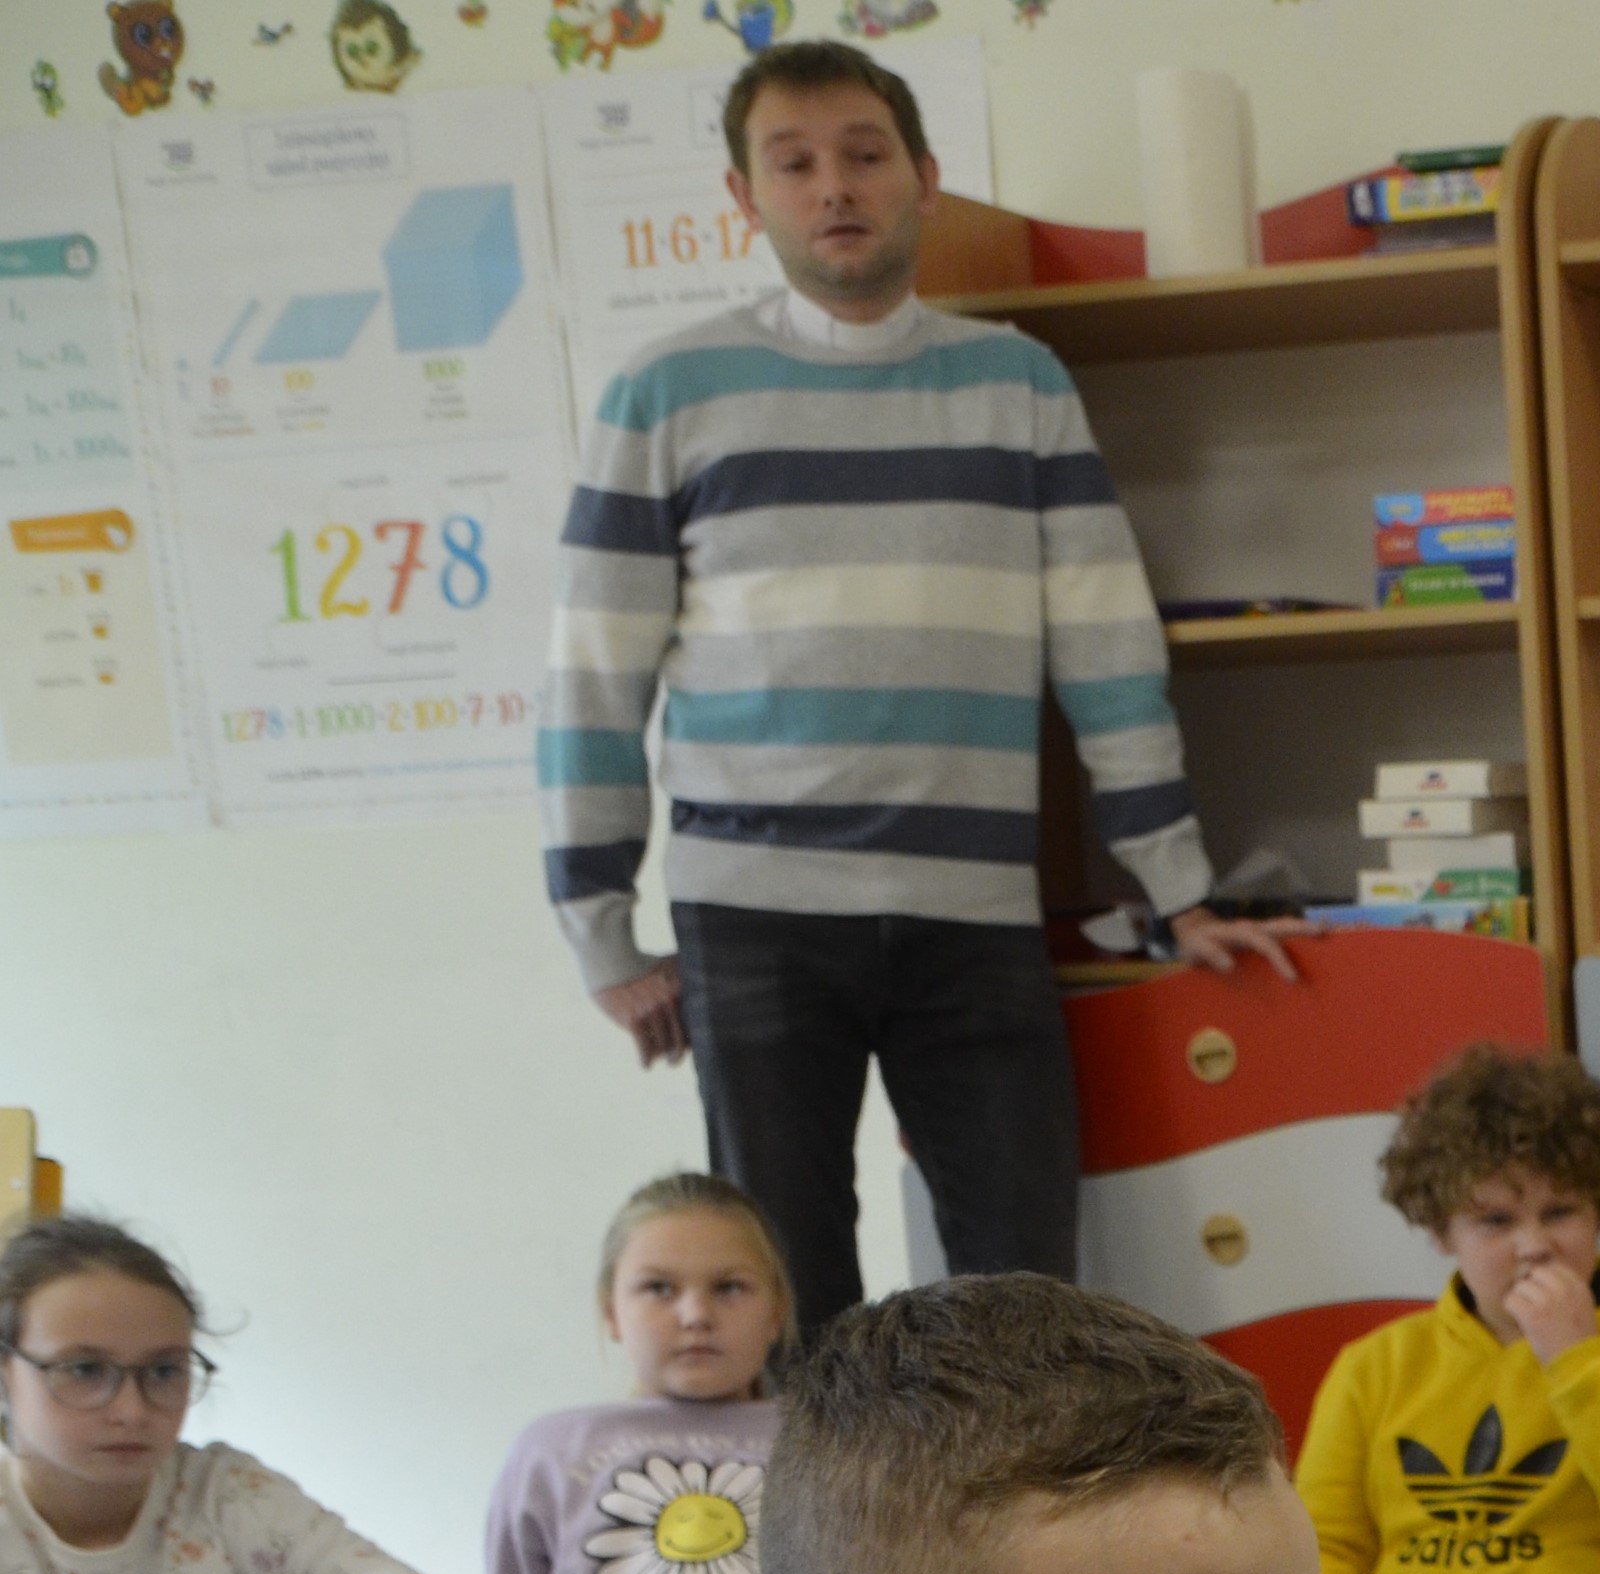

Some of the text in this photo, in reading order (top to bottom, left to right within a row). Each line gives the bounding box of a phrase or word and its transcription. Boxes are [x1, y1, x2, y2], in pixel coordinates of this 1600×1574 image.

[669, 212, 700, 264] 6
[268, 512, 490, 623] 1278
[221, 706, 285, 742] 1278
